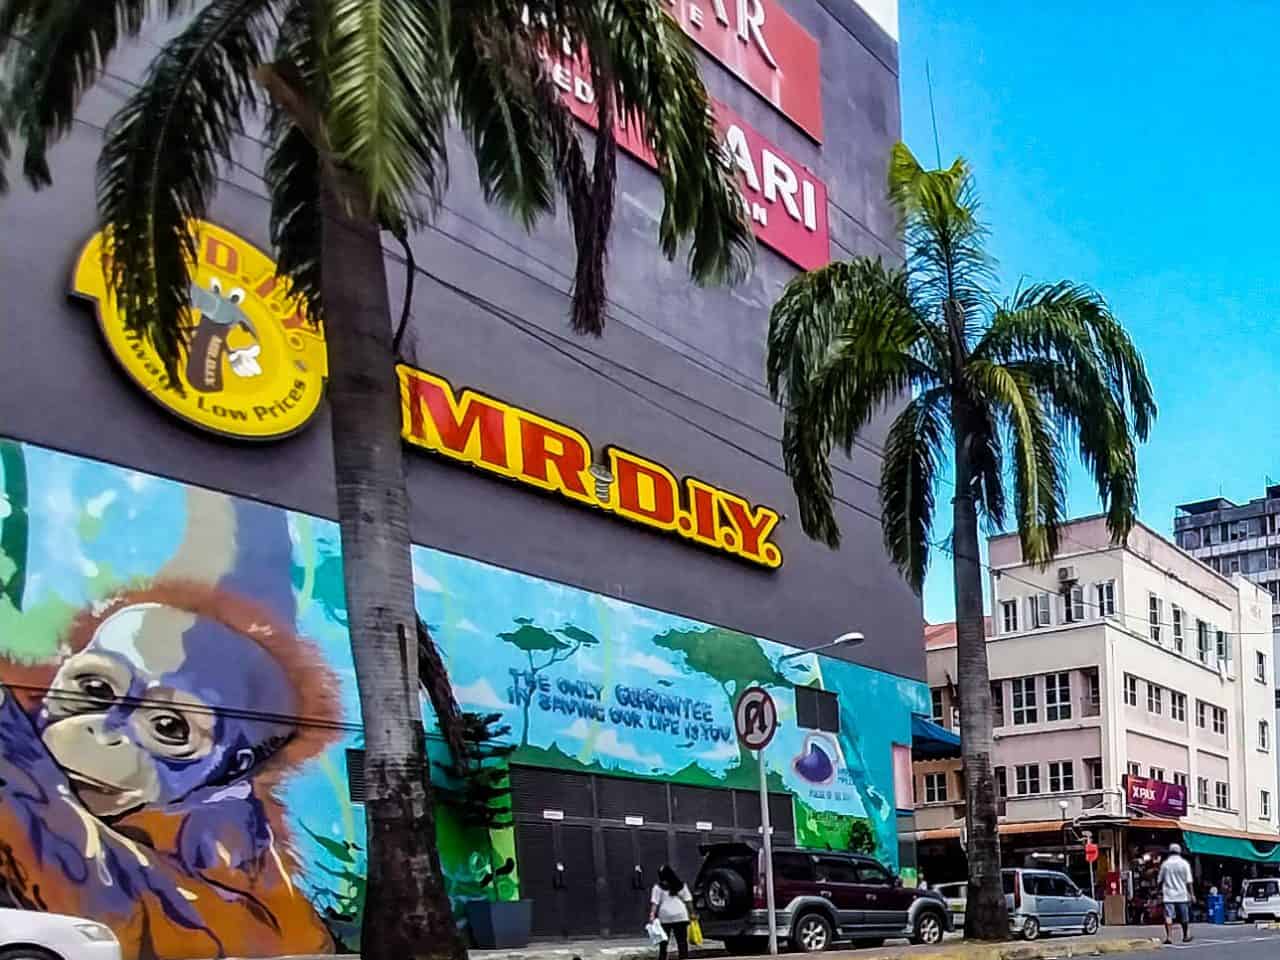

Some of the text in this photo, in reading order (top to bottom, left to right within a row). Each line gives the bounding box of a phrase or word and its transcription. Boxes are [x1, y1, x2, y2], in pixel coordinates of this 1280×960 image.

[198, 396, 248, 421] Low
[253, 379, 307, 422] Prices
[508, 685, 531, 706] IN
[538, 693, 606, 723] SAVING
[609, 707, 644, 729] OUR
[509, 668, 714, 722] THE ONLY GUARANTEE
